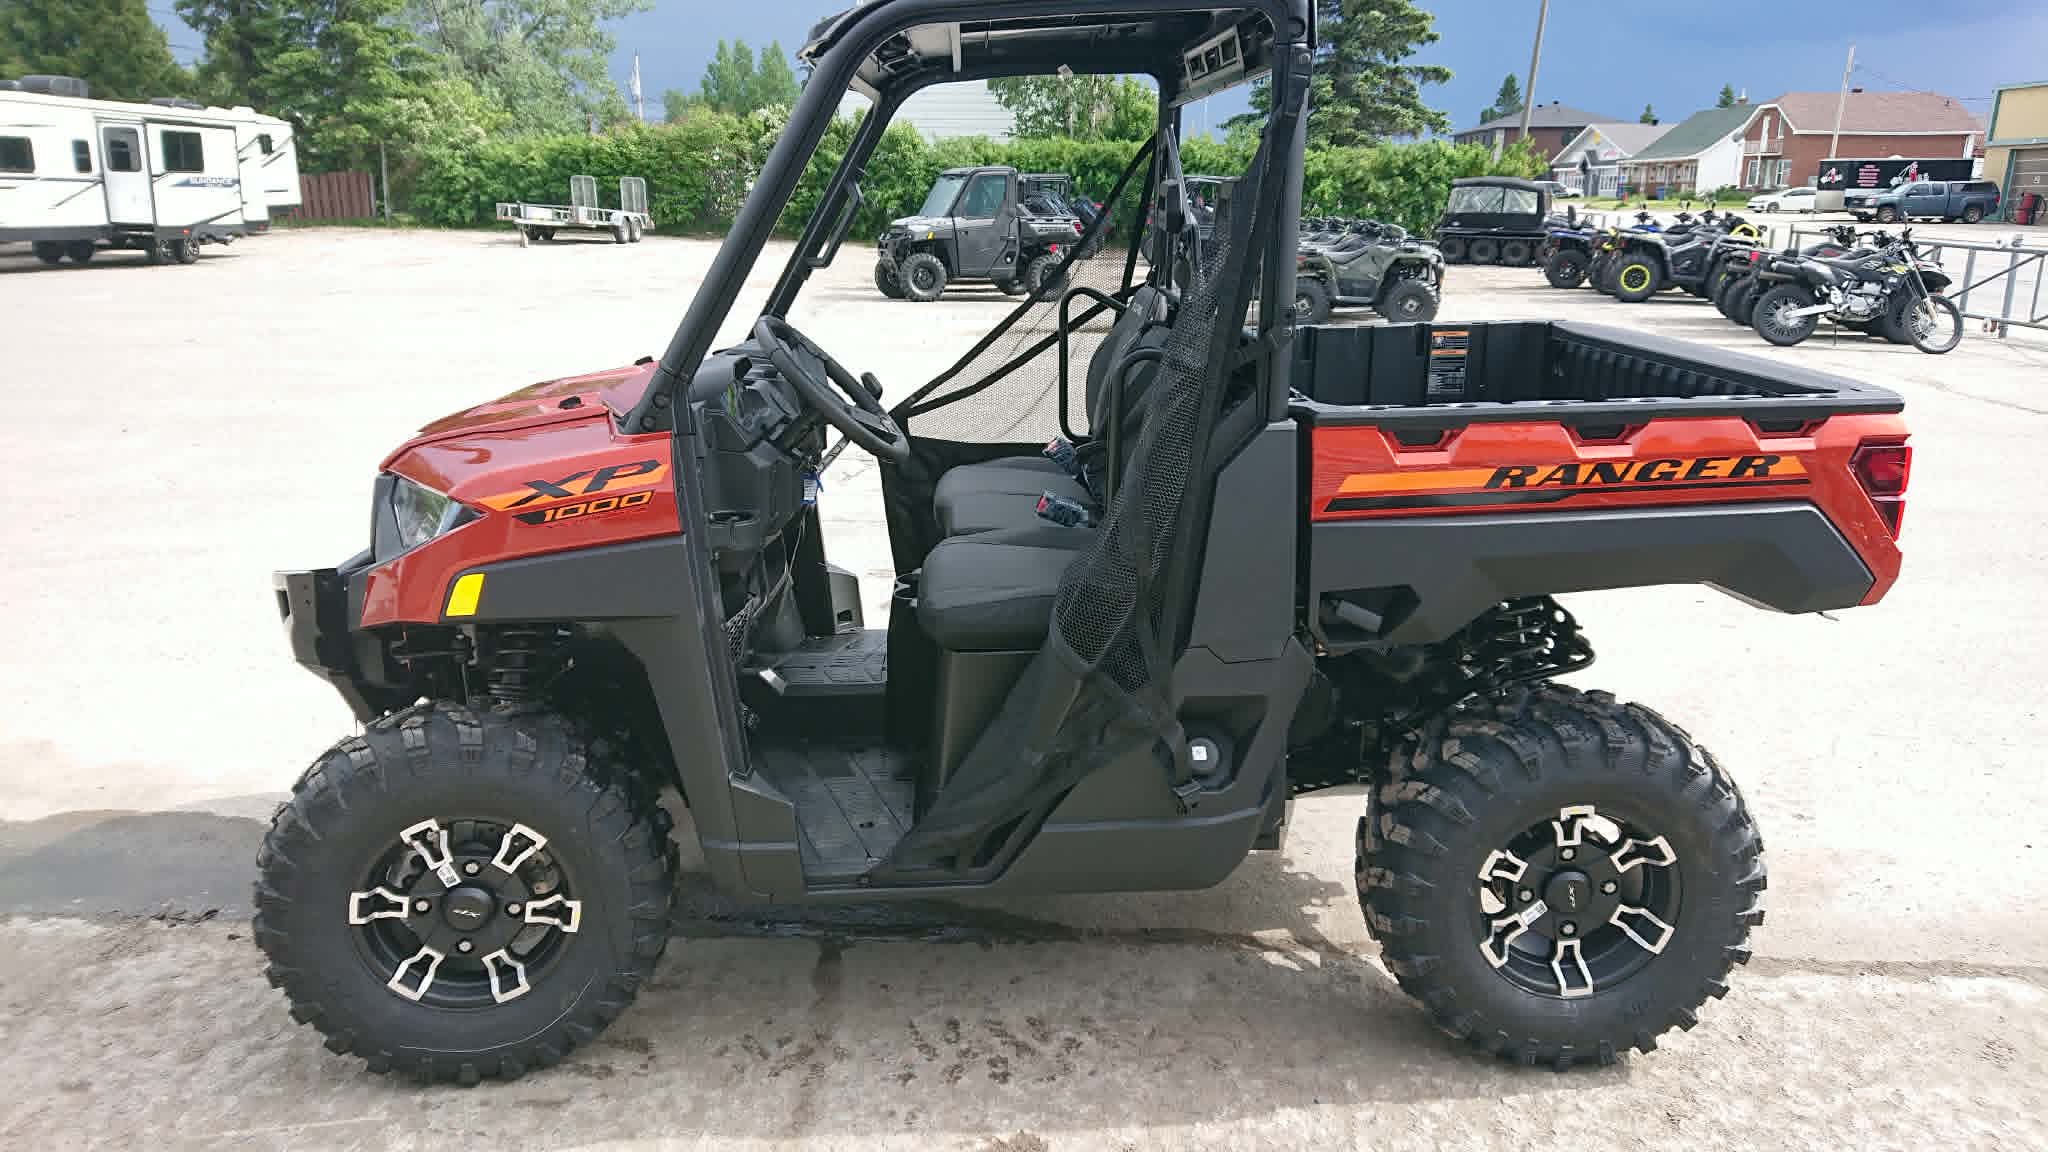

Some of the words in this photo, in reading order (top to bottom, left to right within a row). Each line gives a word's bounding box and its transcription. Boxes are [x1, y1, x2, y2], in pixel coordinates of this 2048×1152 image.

[505, 459, 661, 508] XP
[1483, 455, 1781, 489] RANGER
[543, 491, 654, 523] 1000
